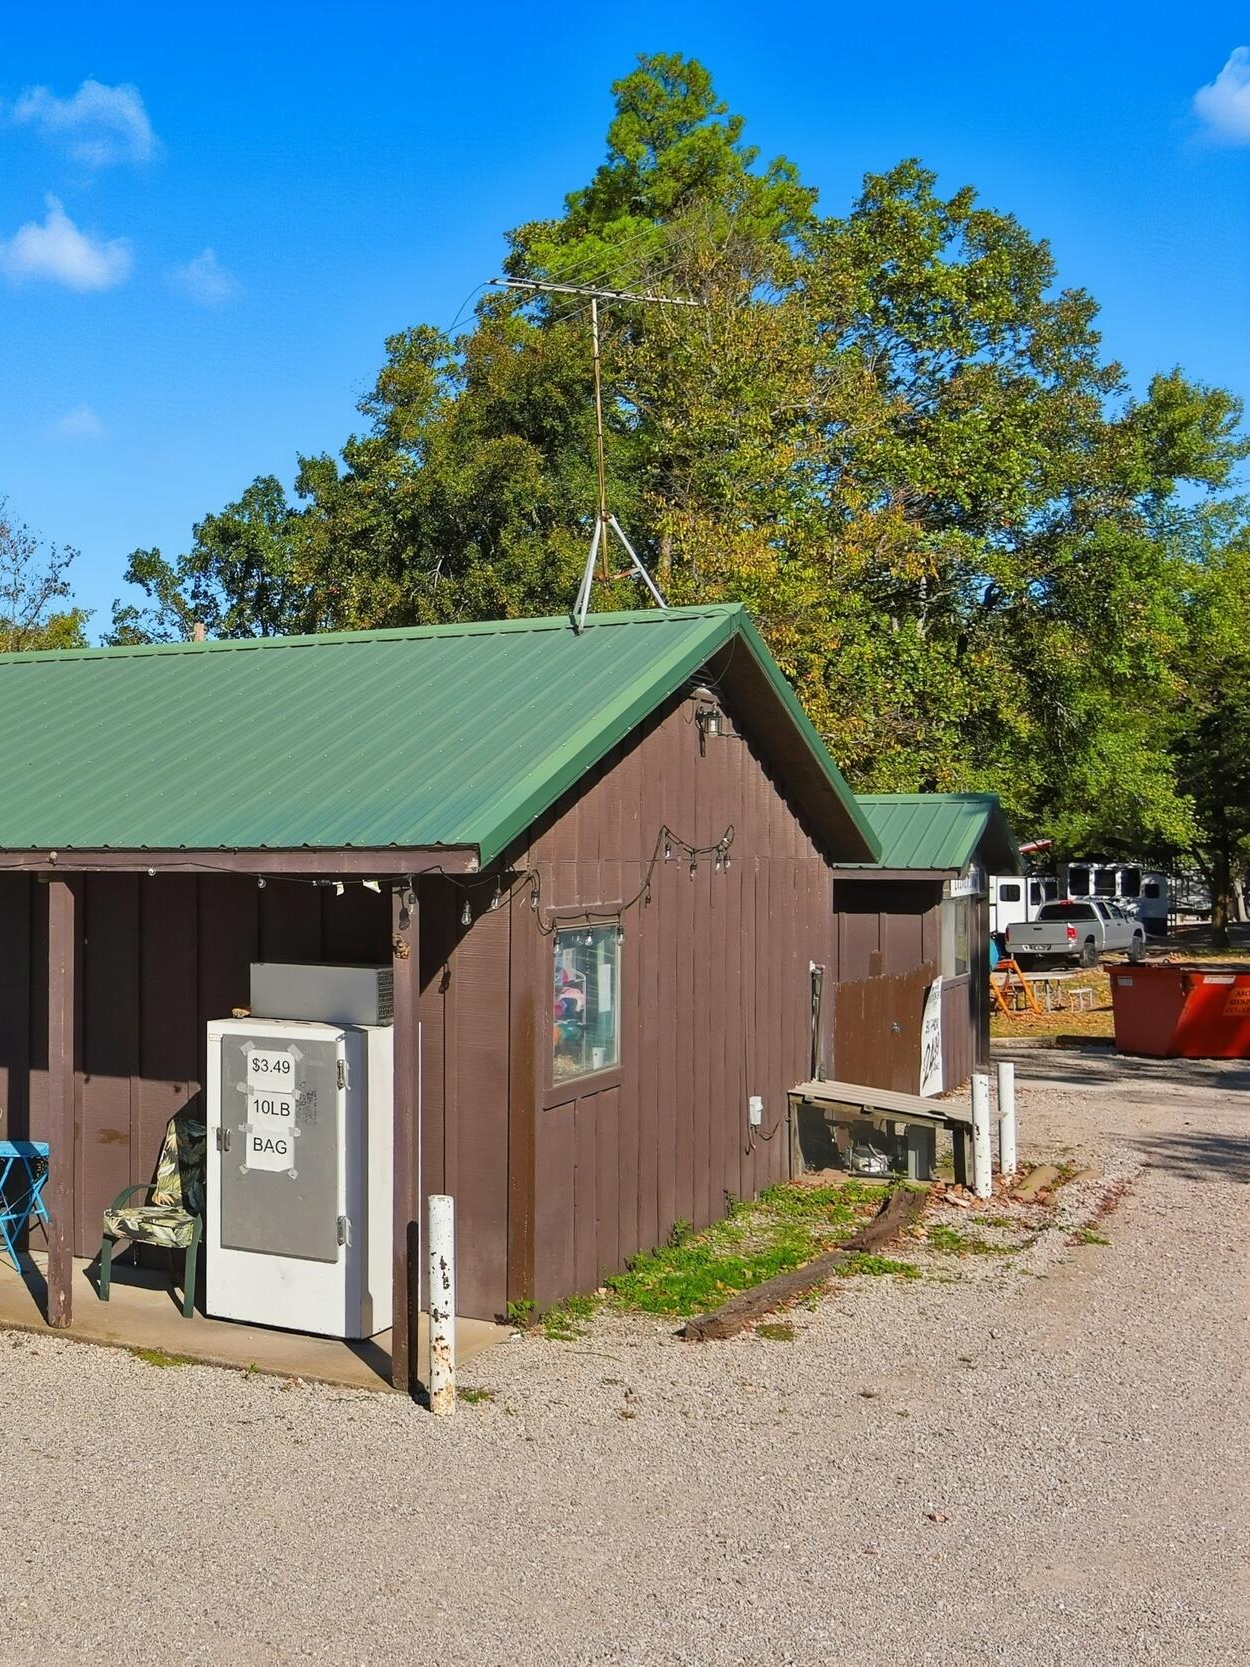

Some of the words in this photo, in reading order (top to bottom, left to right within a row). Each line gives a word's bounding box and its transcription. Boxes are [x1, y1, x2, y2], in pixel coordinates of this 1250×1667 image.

[252, 1058, 290, 1074] $3.49
[253, 1099, 290, 1117] 10LB
[253, 1137, 287, 1155] BAG
